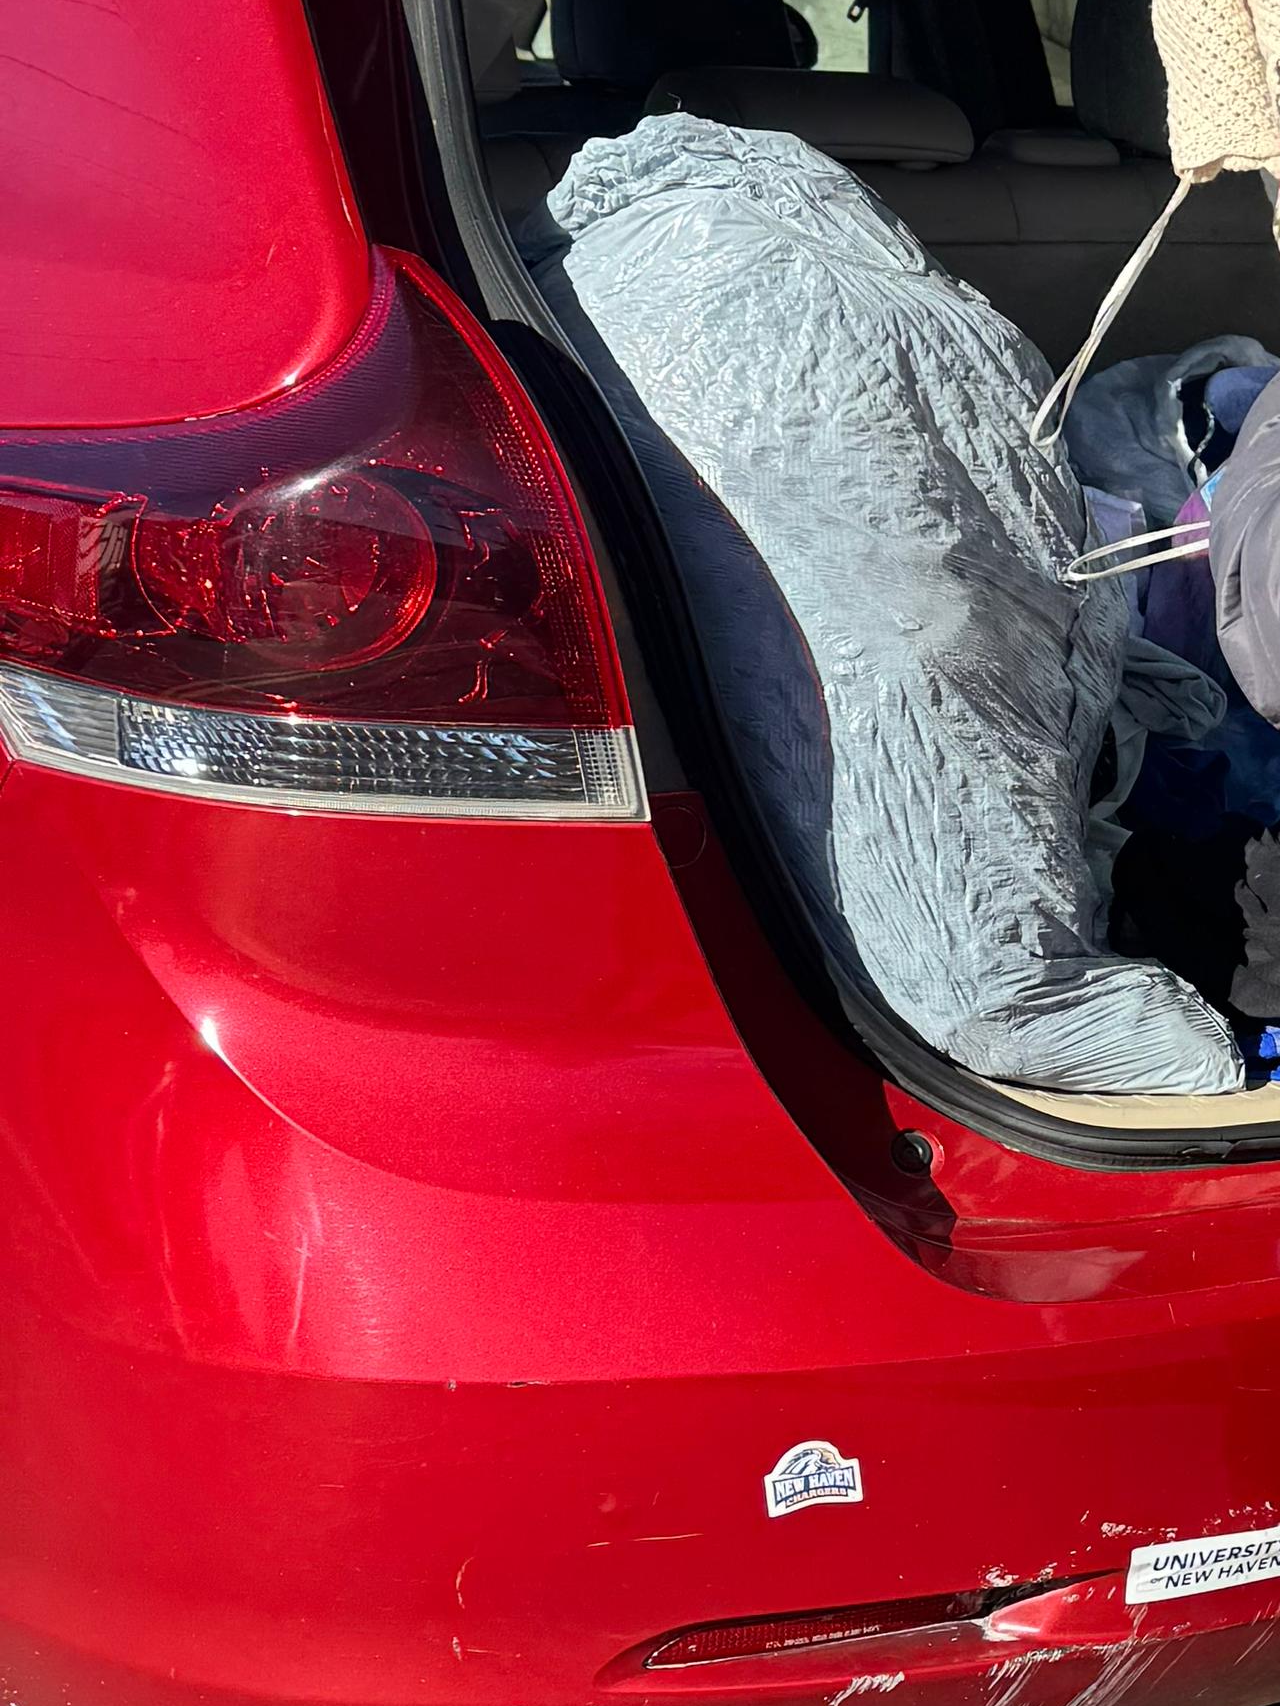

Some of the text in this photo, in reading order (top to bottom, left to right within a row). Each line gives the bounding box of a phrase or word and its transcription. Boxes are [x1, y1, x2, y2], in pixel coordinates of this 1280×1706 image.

[774, 1468, 854, 1502] NEW HAVEN
[1165, 1569, 1213, 1589] NEW
